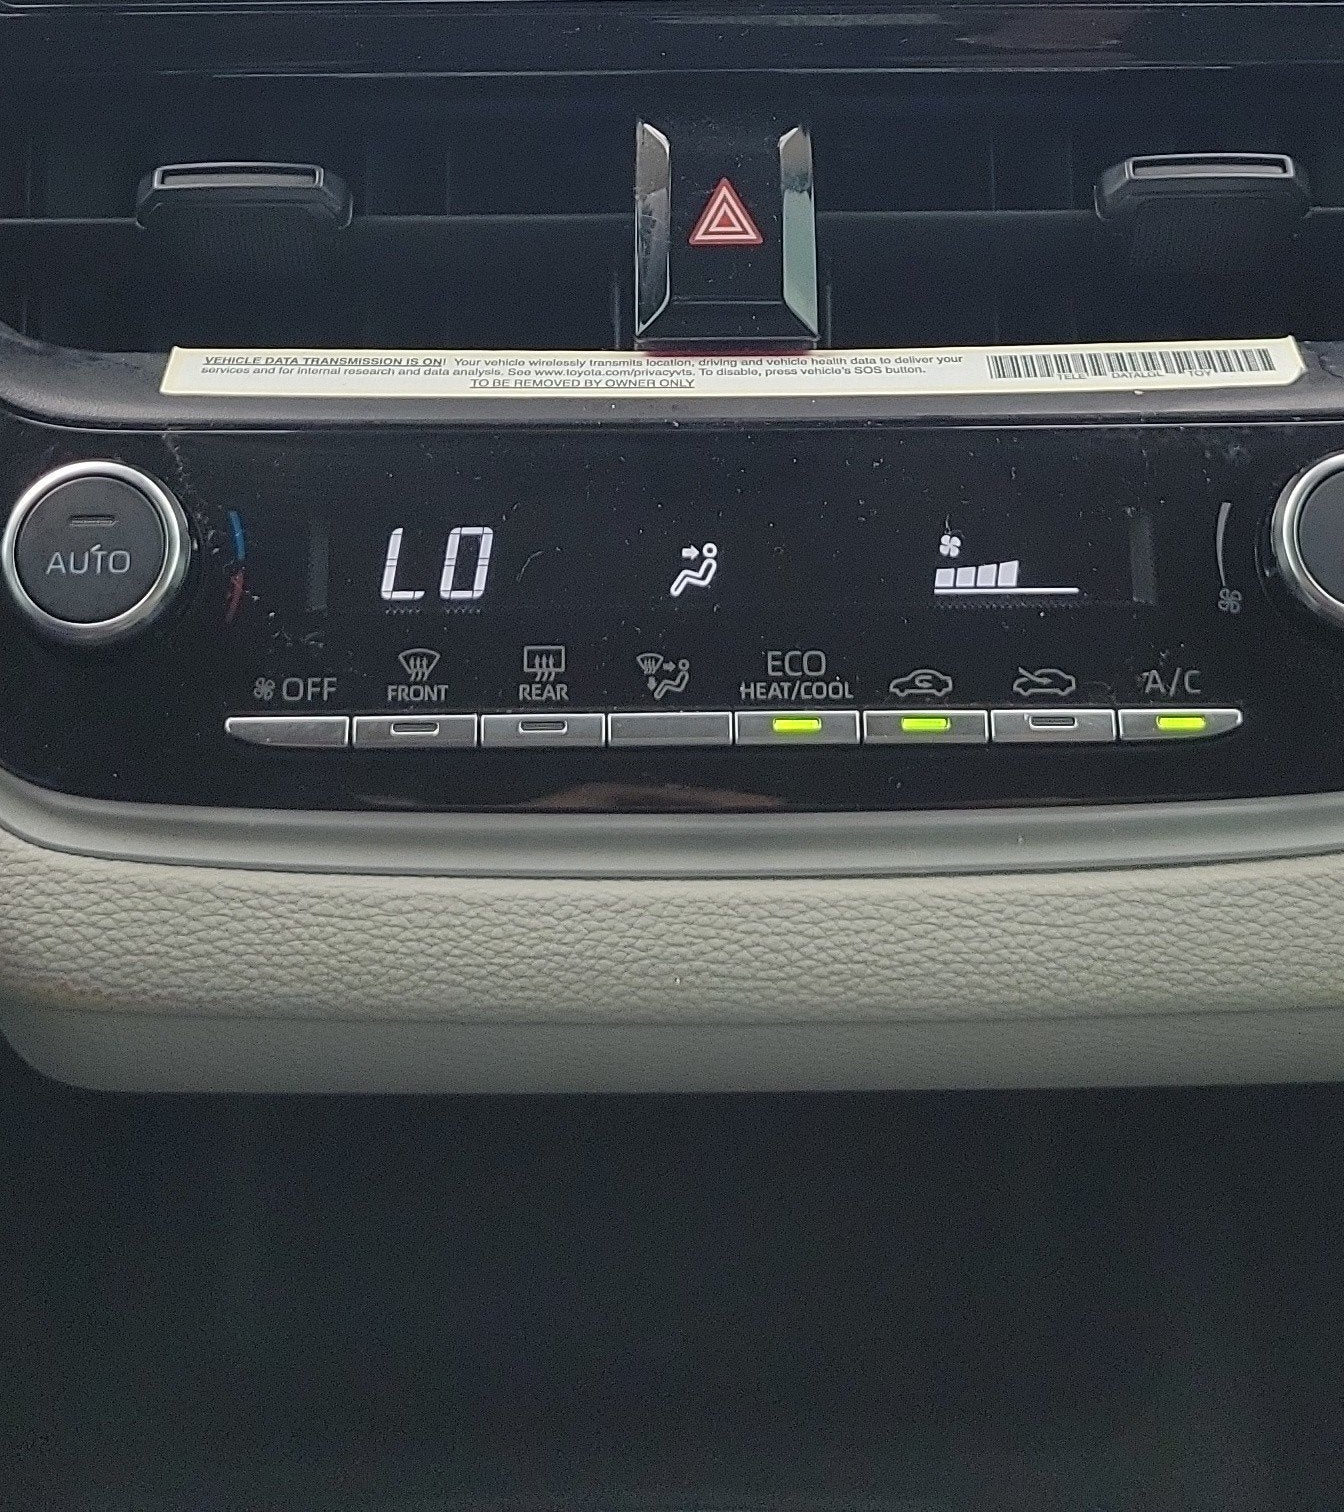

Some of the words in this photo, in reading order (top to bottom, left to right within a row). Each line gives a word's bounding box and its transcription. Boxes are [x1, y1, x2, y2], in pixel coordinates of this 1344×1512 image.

[201, 366, 250, 374] services
[253, 366, 275, 374] and
[278, 366, 294, 374] for
[297, 366, 341, 375] internal
[344, 367, 395, 376] research
[398, 367, 420, 376] and
[423, 367, 449, 376] data
[453, 367, 504, 377] analysis.
[508, 367, 531, 376] See
[699, 368, 713, 376] To
[716, 367, 762, 377] disable,
[765, 368, 798, 377] press
[801, 366, 851, 375] vehicle's
[854, 366, 882, 374] SOS
[885, 365, 926, 374] button.
[205, 356, 262, 365] VEHICLE
[265, 357, 299, 365] DATA
[304, 357, 403, 365] TRANSMISSION
[406, 357, 419, 365] IS
[423, 357, 446, 366] ON!
[455, 358, 481, 367] Your
[484, 358, 526, 367] vehicle
[529, 358, 586, 369] wirelessly
[590, 358, 643, 367] transmits
[646, 358, 695, 368] location,
[698, 358, 737, 368] driving
[741, 358, 763, 366] and
[766, 357, 807, 366] vehicle
[811, 357, 847, 365] health
[850, 357, 877, 365] data
[880, 356, 891, 364] to
[895, 356, 933, 364] deliver
[937, 356, 963, 365] your
[471, 378, 489, 387] TO
[492, 378, 510, 387] BE
[514, 378, 580, 387] REMOVED
[584, 378, 602, 387] BY
[605, 378, 656, 387] OWNER
[659, 378, 695, 387] ONLY
[46, 549, 131, 575] AUTO
[765, 650, 827, 677] ECO
[283, 677, 337, 702] OFF
[740, 680, 854, 701] HEAT/COOL
[1143, 668, 1202, 696] A/C
[387, 684, 449, 702] FRONT
[518, 684, 569, 702] REAR
